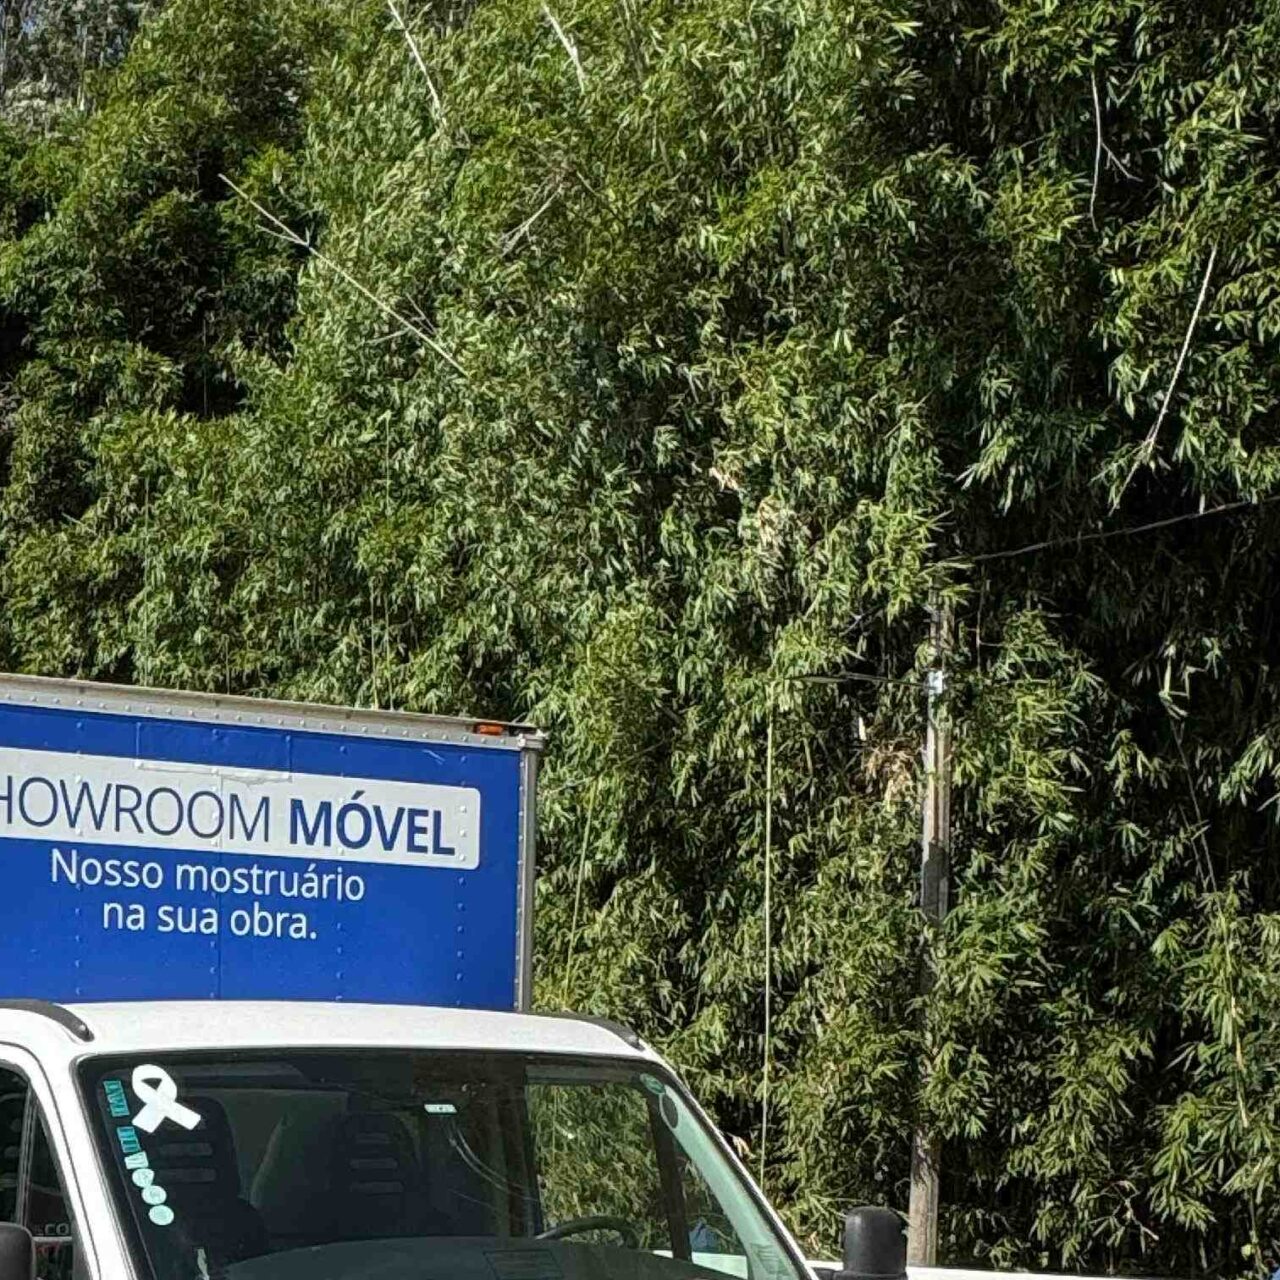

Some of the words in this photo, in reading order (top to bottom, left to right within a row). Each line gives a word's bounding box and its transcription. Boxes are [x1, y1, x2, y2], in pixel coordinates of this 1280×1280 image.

[290, 791, 455, 856] MÓVEL
[51, 849, 163, 889] Nosso
[176, 860, 365, 901] mostruário
[103, 901, 145, 931] na
[157, 904, 218, 934] sua
[230, 903, 318, 939] obra.
